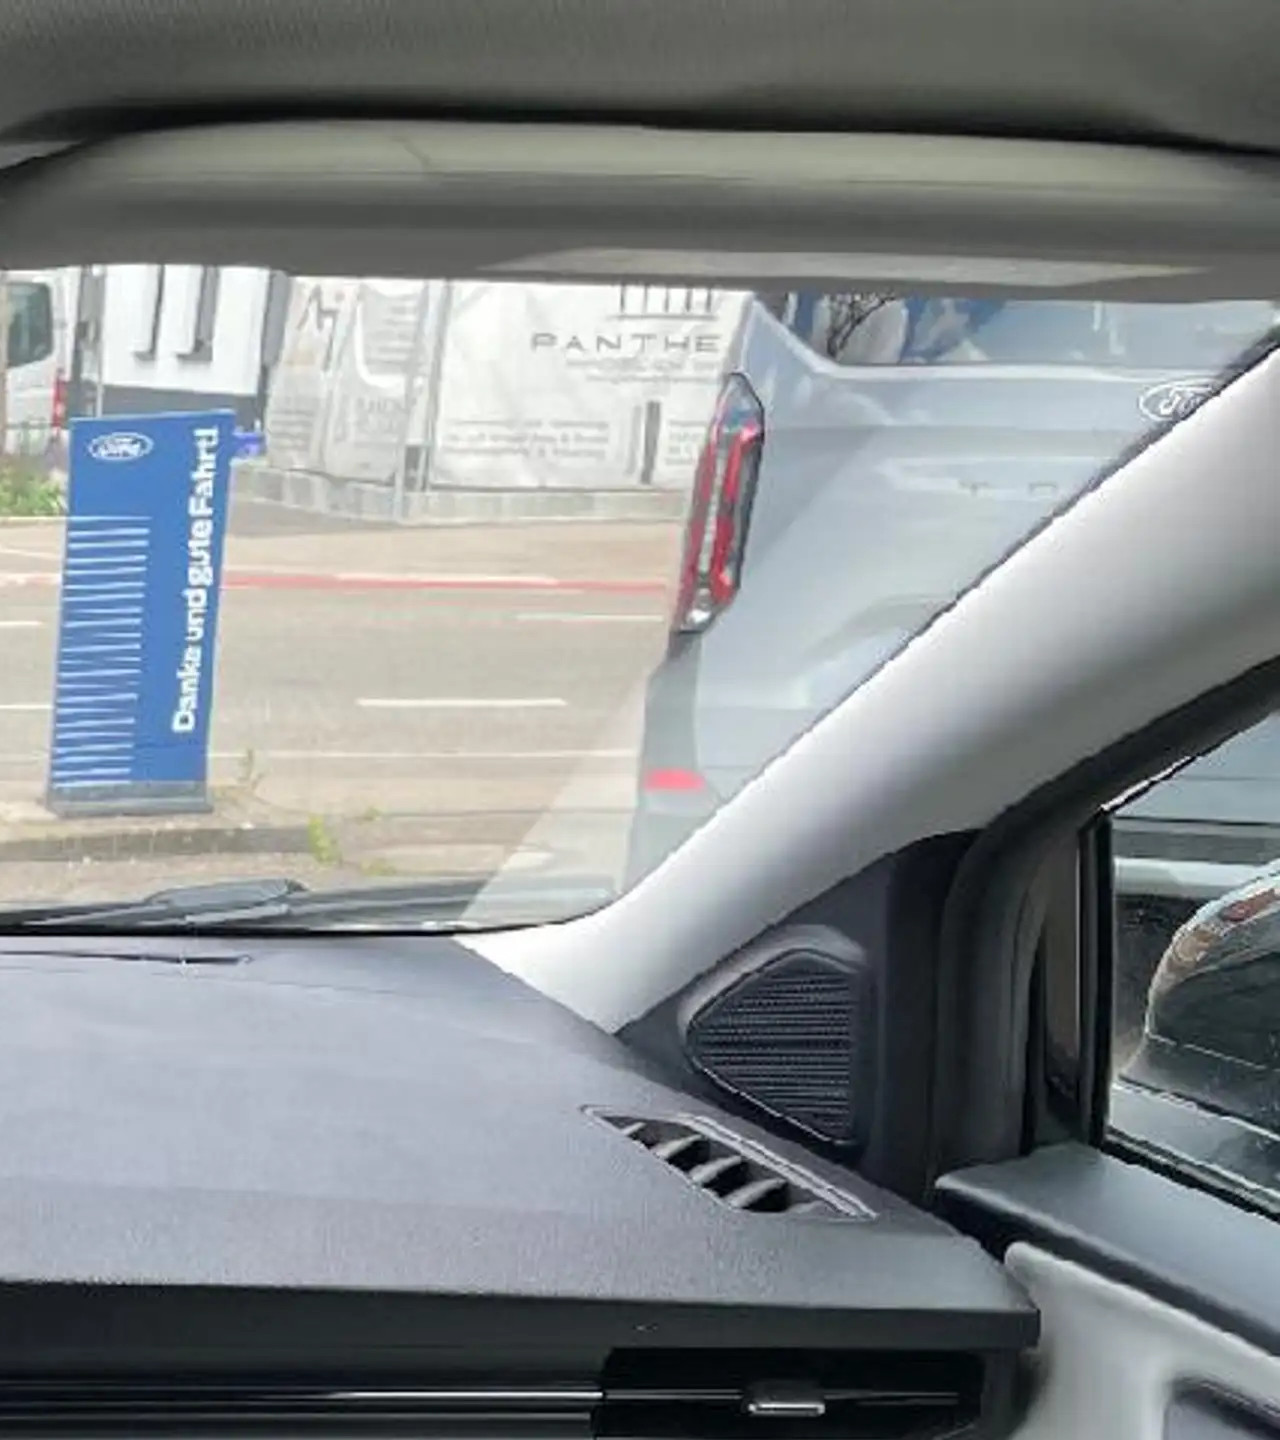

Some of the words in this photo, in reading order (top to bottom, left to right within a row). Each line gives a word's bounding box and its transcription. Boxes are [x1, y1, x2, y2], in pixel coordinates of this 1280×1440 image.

[187, 518, 214, 587] gute
[180, 587, 208, 641] und
[172, 646, 202, 733] Danke
